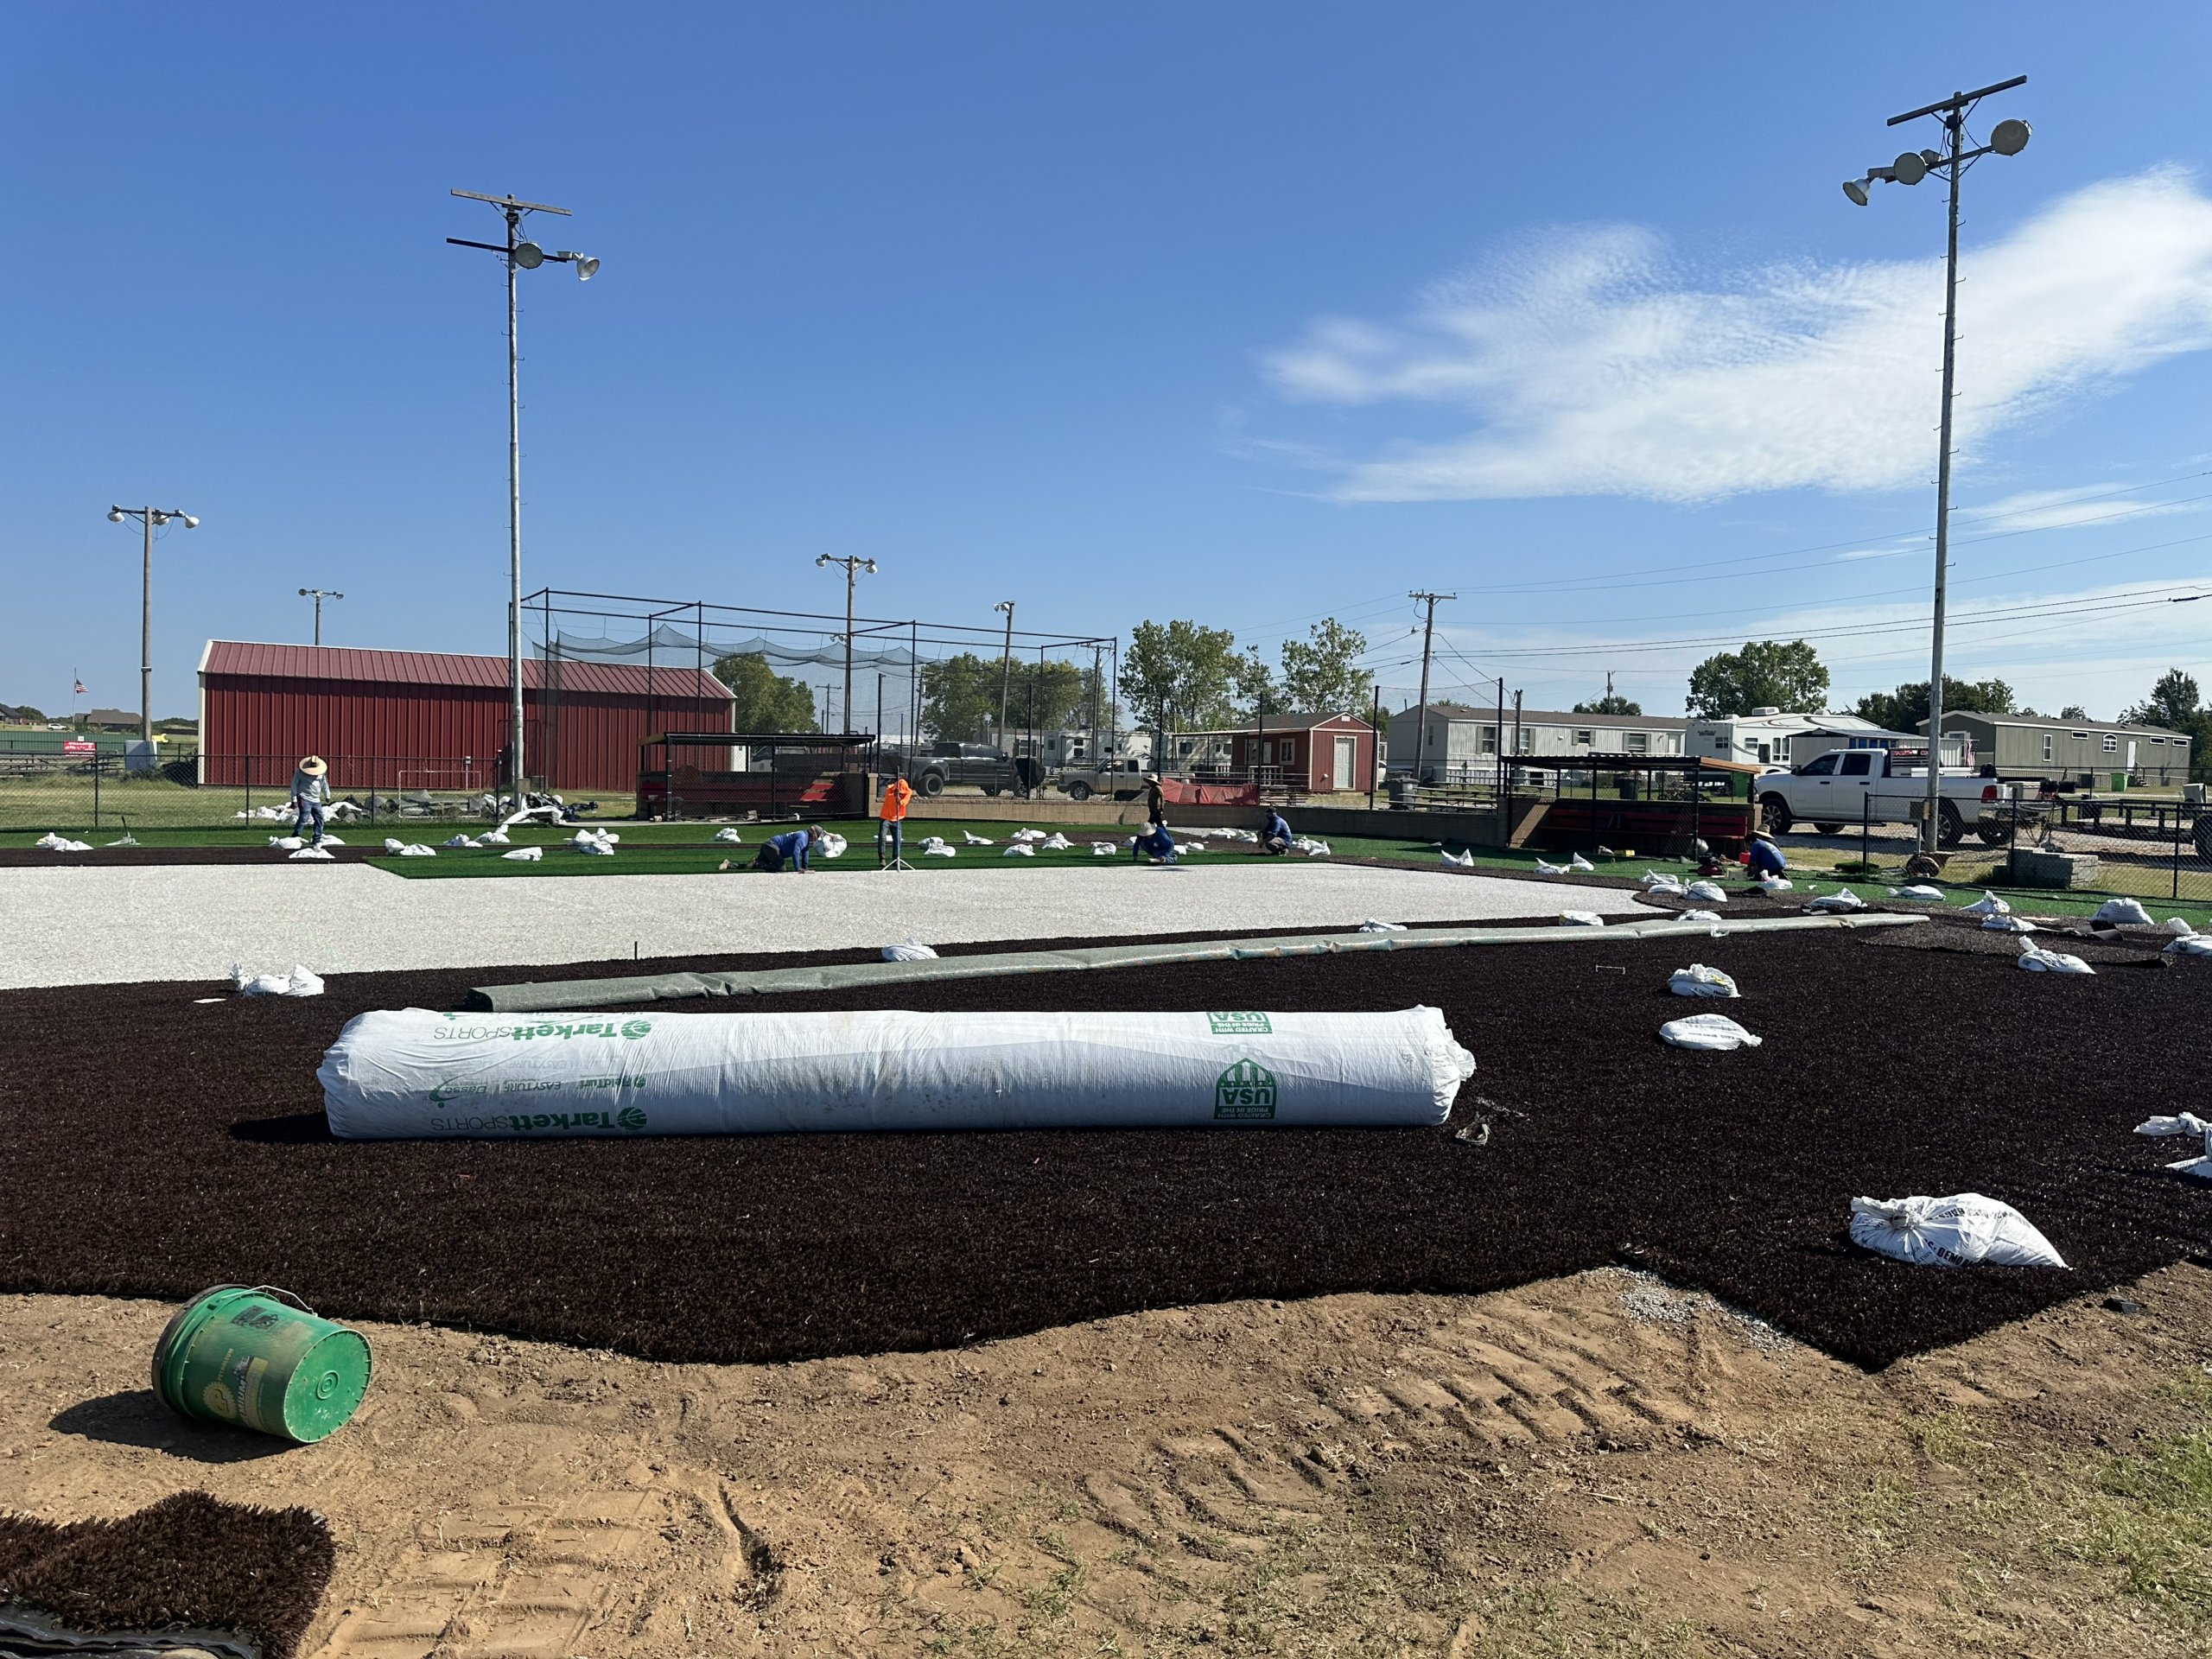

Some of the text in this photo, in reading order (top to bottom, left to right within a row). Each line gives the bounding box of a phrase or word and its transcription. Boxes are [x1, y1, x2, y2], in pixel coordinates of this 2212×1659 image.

[443, 1084, 486, 1094] Desso
[502, 1081, 561, 1092] EASYTURF
[1222, 1089, 1270, 1105] USA
[1875, 1247, 1897, 1255] RYWALL
[1936, 1247, 1963, 1265] DEMO
[217, 1347, 234, 1382] PETROLEUM
